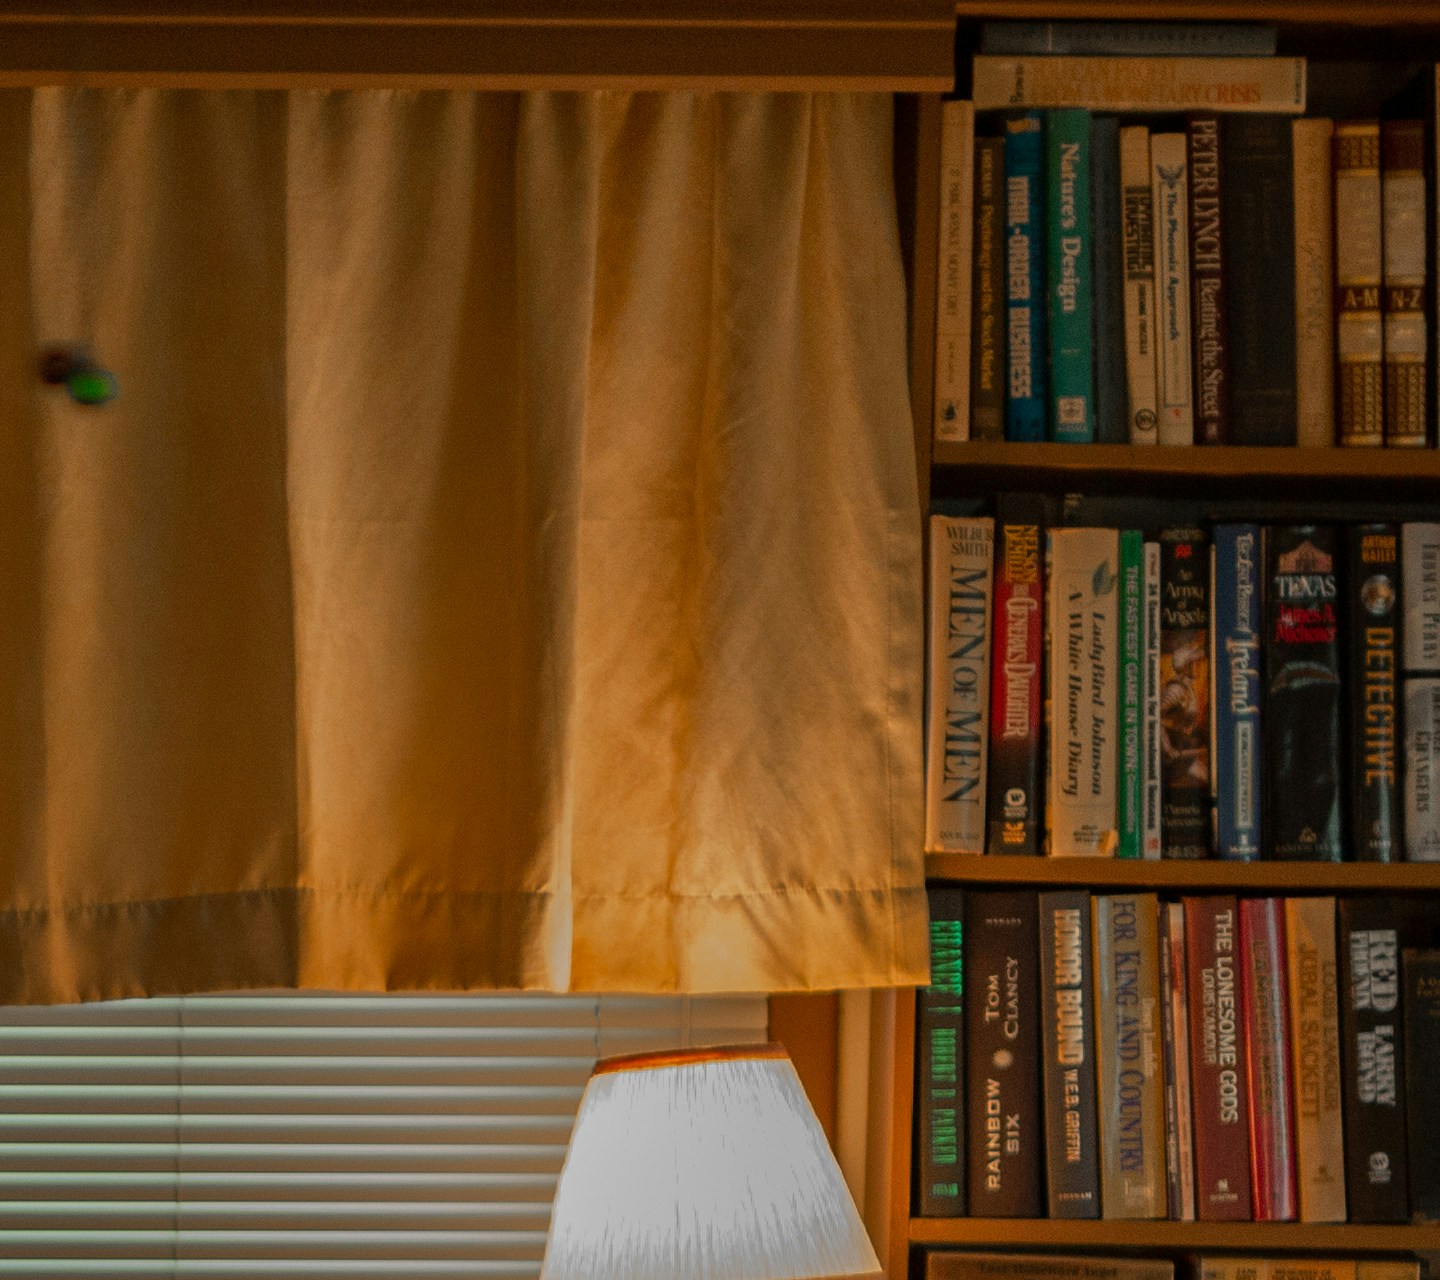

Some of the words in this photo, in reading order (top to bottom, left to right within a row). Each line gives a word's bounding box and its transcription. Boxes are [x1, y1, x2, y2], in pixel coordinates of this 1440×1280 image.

[1060, 144, 1081, 230] Nature's
[1194, 190, 1219, 270] LYNCH
[1058, 237, 1081, 313] Design
[1344, 291, 1378, 308] A-M
[1392, 290, 1421, 307] N-Z
[951, 541, 988, 557] SMITH
[950, 567, 987, 661] MEN
[1275, 575, 1336, 597] TEXAS
[952, 667, 979, 698] OF
[1365, 627, 1396, 786] DETECTIVE
[942, 708, 983, 806] MEN
[1112, 902, 1134, 943] FOR
[1216, 910, 1233, 952] THE
[984, 975, 999, 1023] TOM
[1003, 956, 1020, 1040] CLANCY
[1217, 958, 1237, 1062] LONESOME
[1220, 1067, 1238, 1123] GODS
[984, 1077, 1002, 1193] RAINBOW
[1005, 1113, 1020, 1155] SIX
